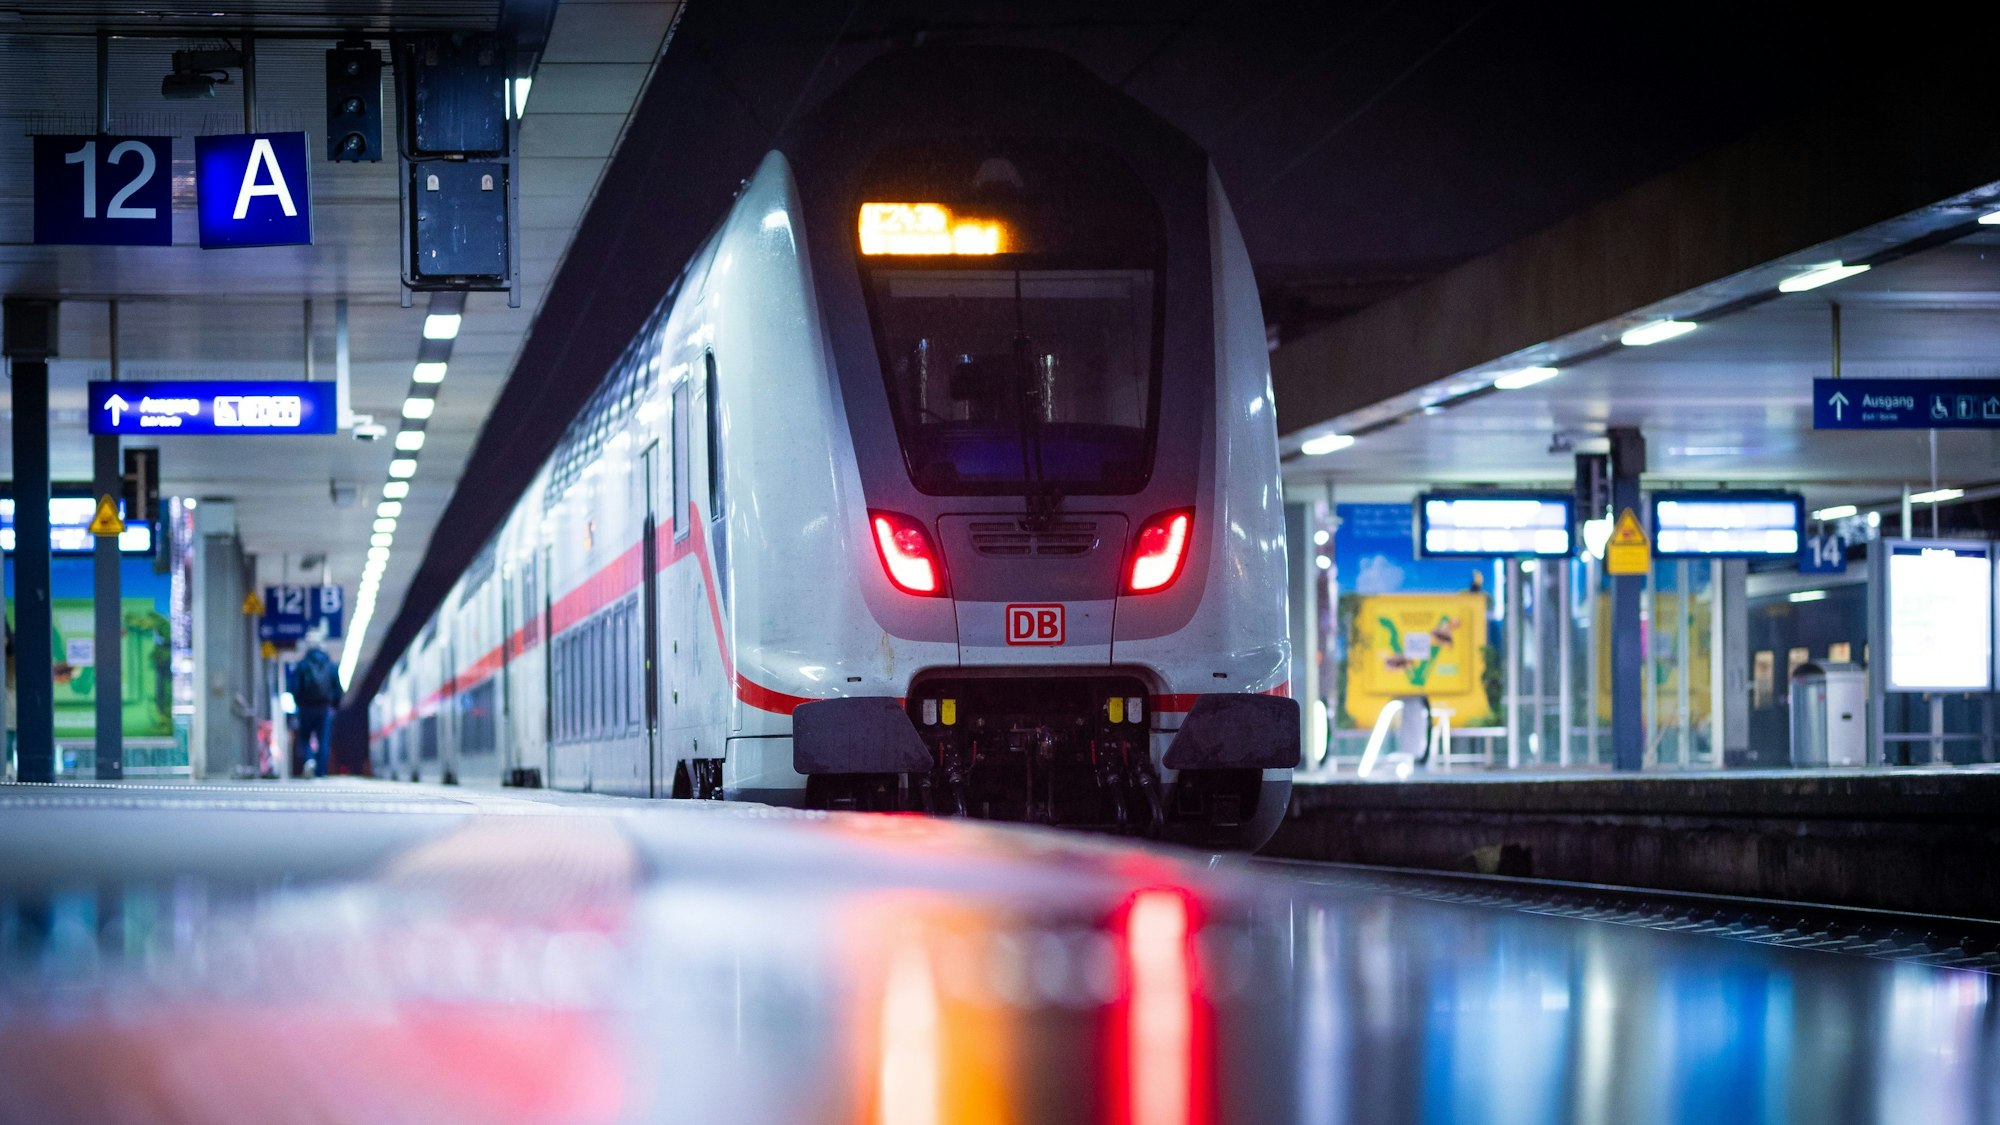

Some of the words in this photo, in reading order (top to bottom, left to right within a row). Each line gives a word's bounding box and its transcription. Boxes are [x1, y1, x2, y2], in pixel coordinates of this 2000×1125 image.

[64, 140, 157, 219] 12
[232, 138, 298, 219] A
[1862, 393, 1914, 410] Ausgang
[1808, 535, 1841, 568] 14
[273, 585, 303, 614] 12
[320, 586, 341, 613] B
[1013, 610, 1058, 639] DB
